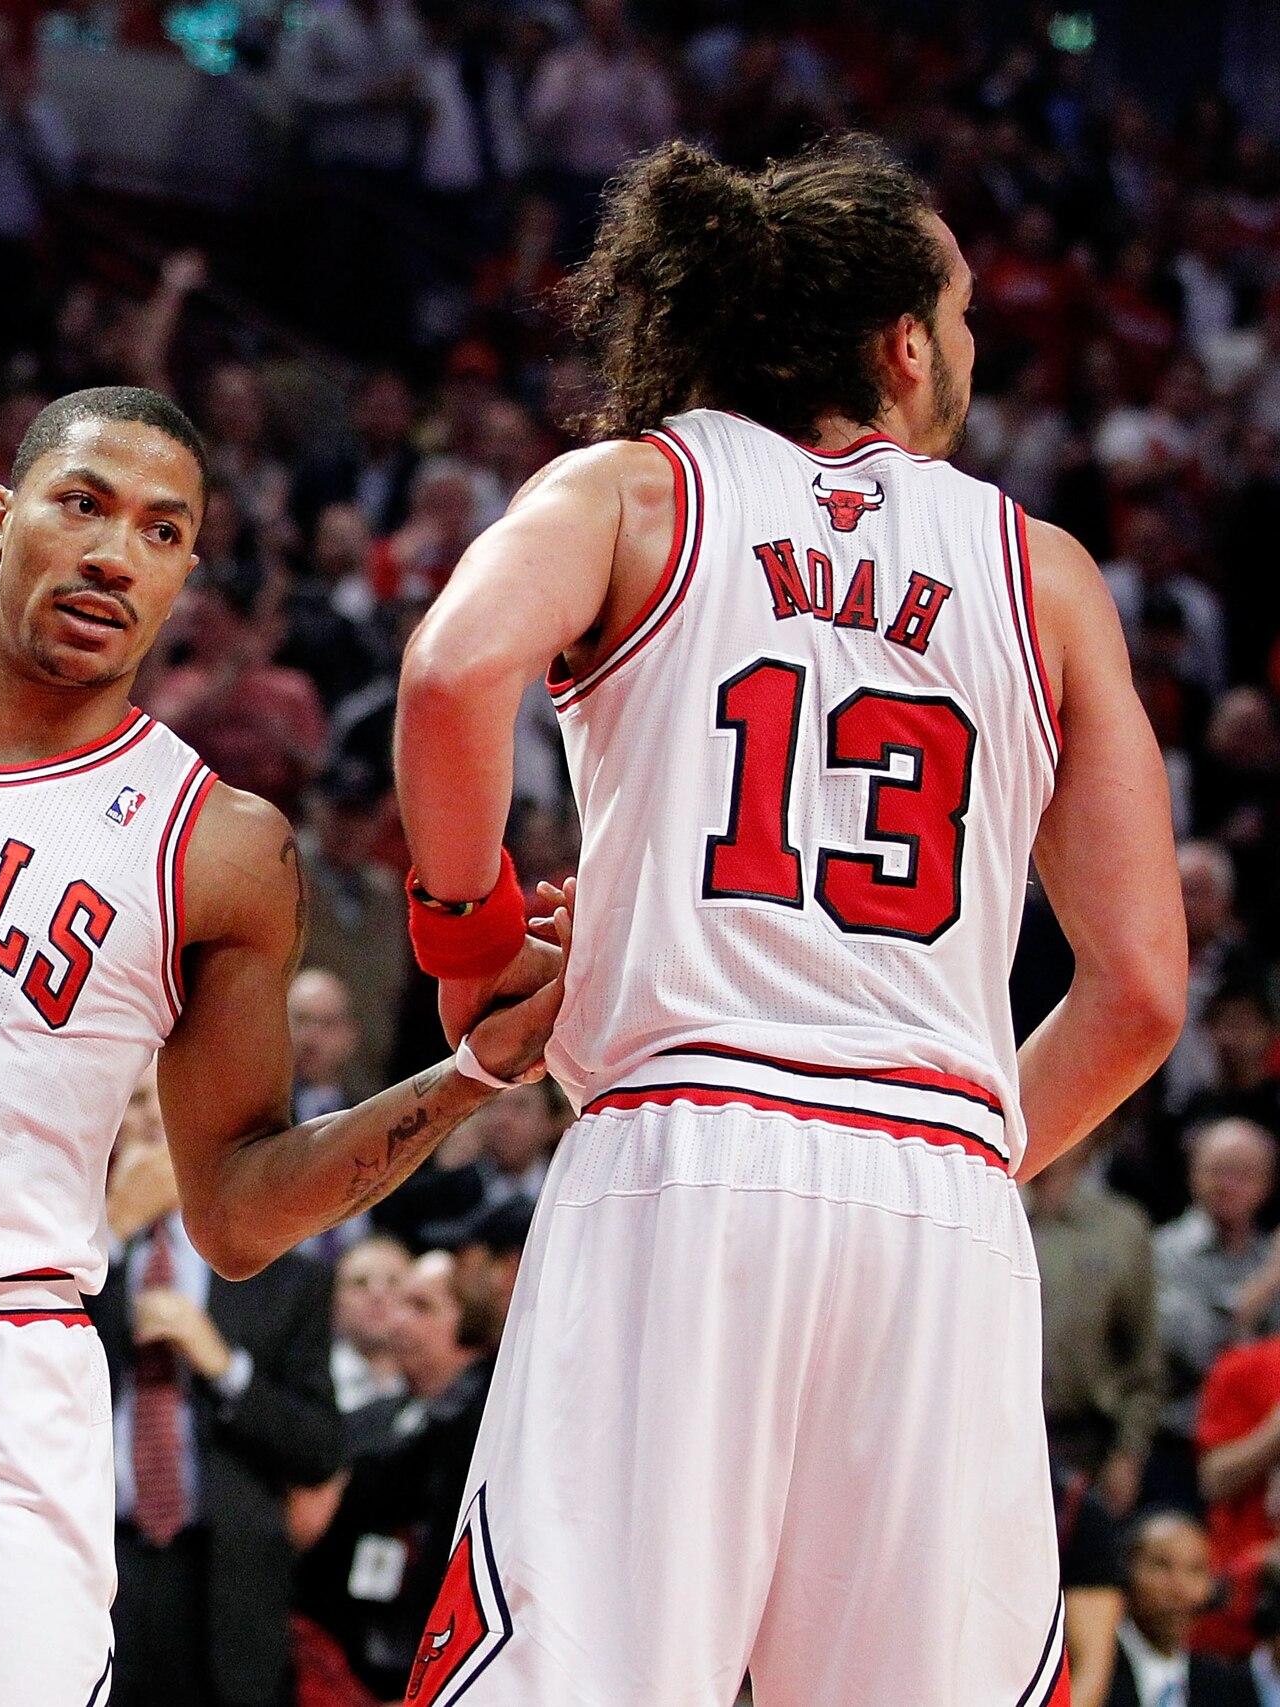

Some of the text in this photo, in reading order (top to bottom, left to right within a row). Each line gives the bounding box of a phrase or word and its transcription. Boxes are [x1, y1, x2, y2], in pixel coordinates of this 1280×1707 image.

[753, 537, 952, 655] NOAH
[107, 809, 122, 822] NBA
[702, 656, 978, 947] 13
